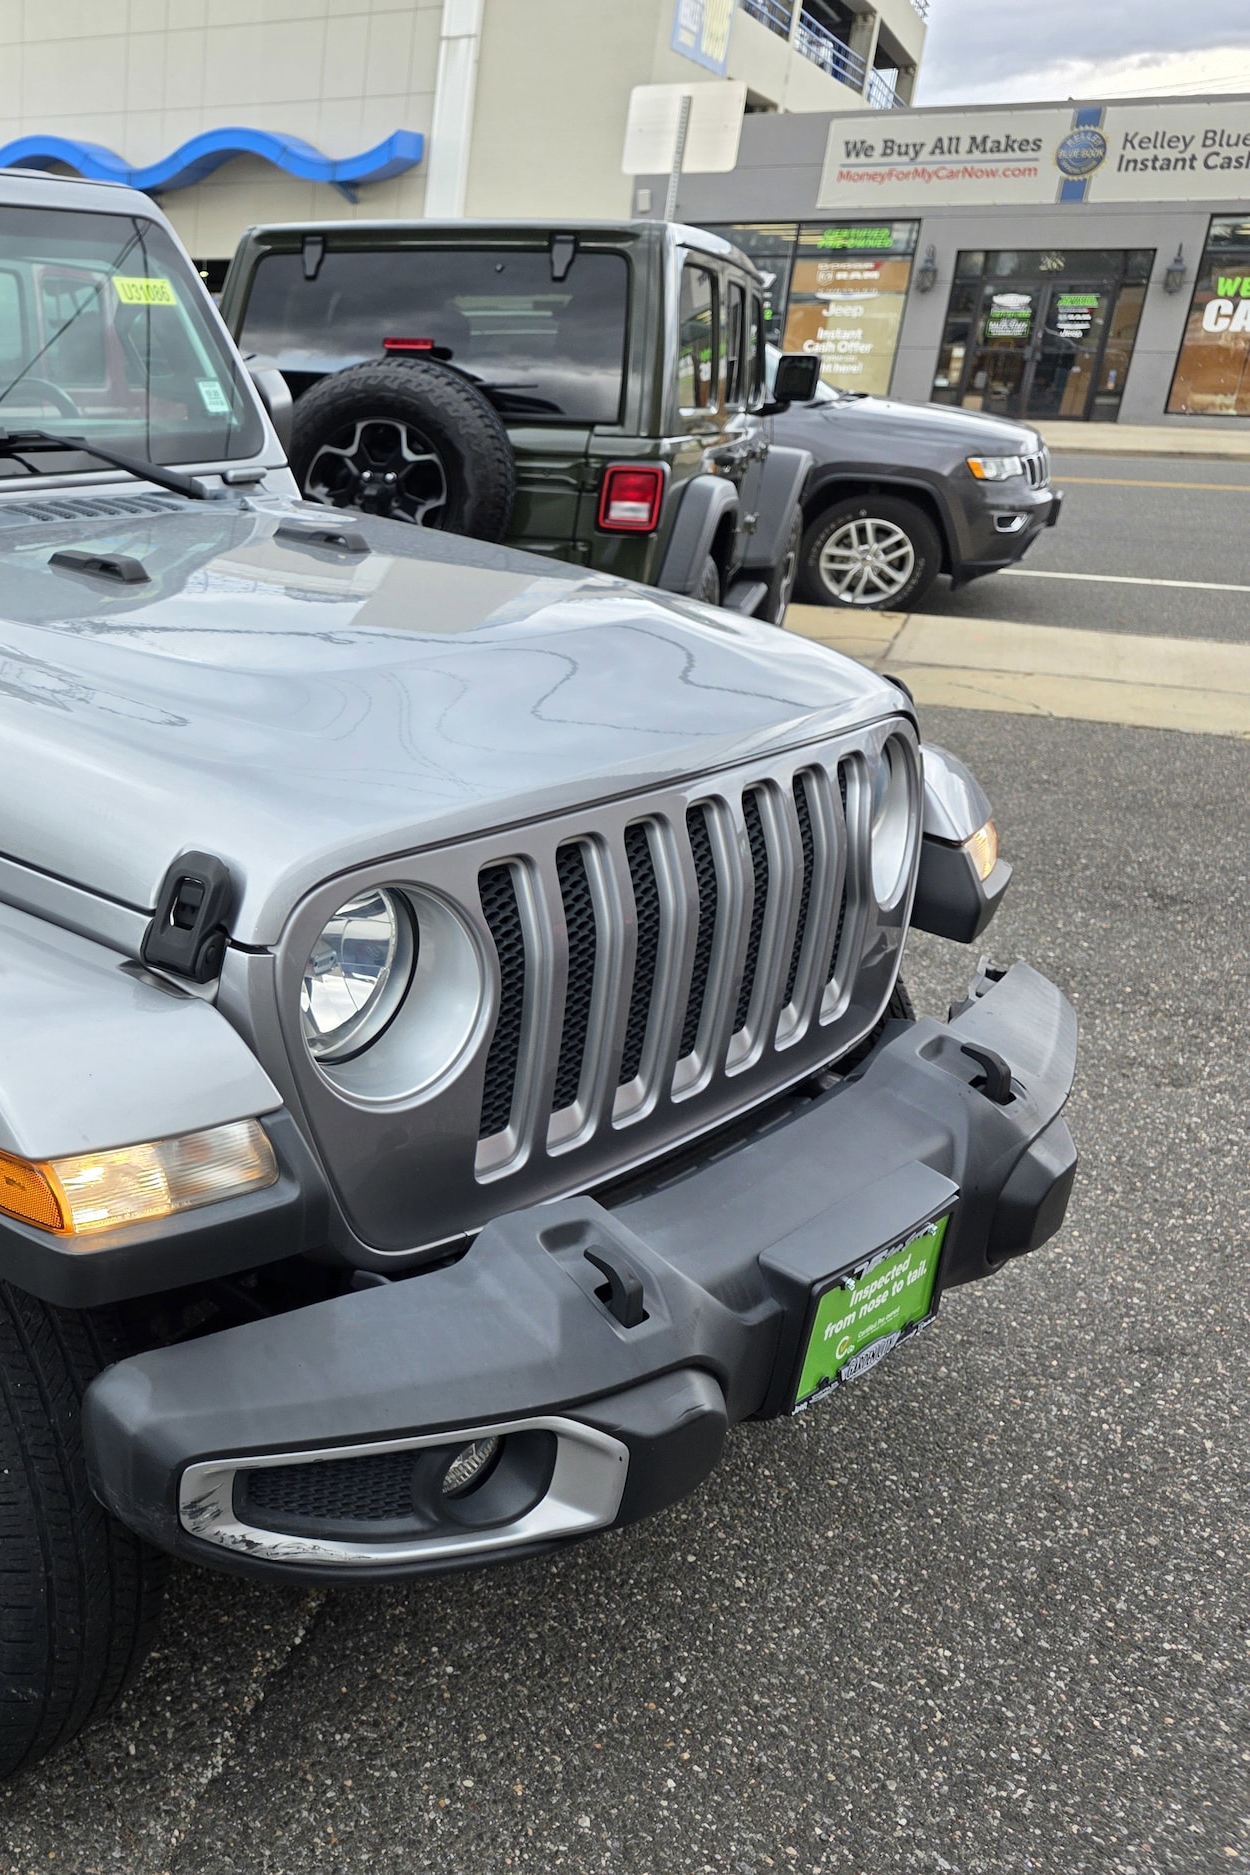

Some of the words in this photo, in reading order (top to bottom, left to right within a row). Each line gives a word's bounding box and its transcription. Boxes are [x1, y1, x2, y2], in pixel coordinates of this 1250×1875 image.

[844, 140, 874, 159] We
[880, 138, 926, 161] Buy
[929, 135, 961, 156] All
[966, 133, 1042, 155] Makes
[1122, 131, 1195, 153] Kelley
[1201, 128, 1250, 147] Blue
[1117, 153, 1197, 172] Instant
[837, 165, 1038, 185] MoneyForMyCarNow.com
[822, 303, 864, 318] Jeep
[817, 327, 863, 340] Instant
[803, 339, 836, 354] Cash
[836, 340, 873, 354] Offer
[849, 1253, 912, 1308] Inspected
[824, 1311, 856, 1341] from
[858, 1290, 889, 1319] nose
[892, 1279, 905, 1297] to
[907, 1259, 927, 1287] tail.
